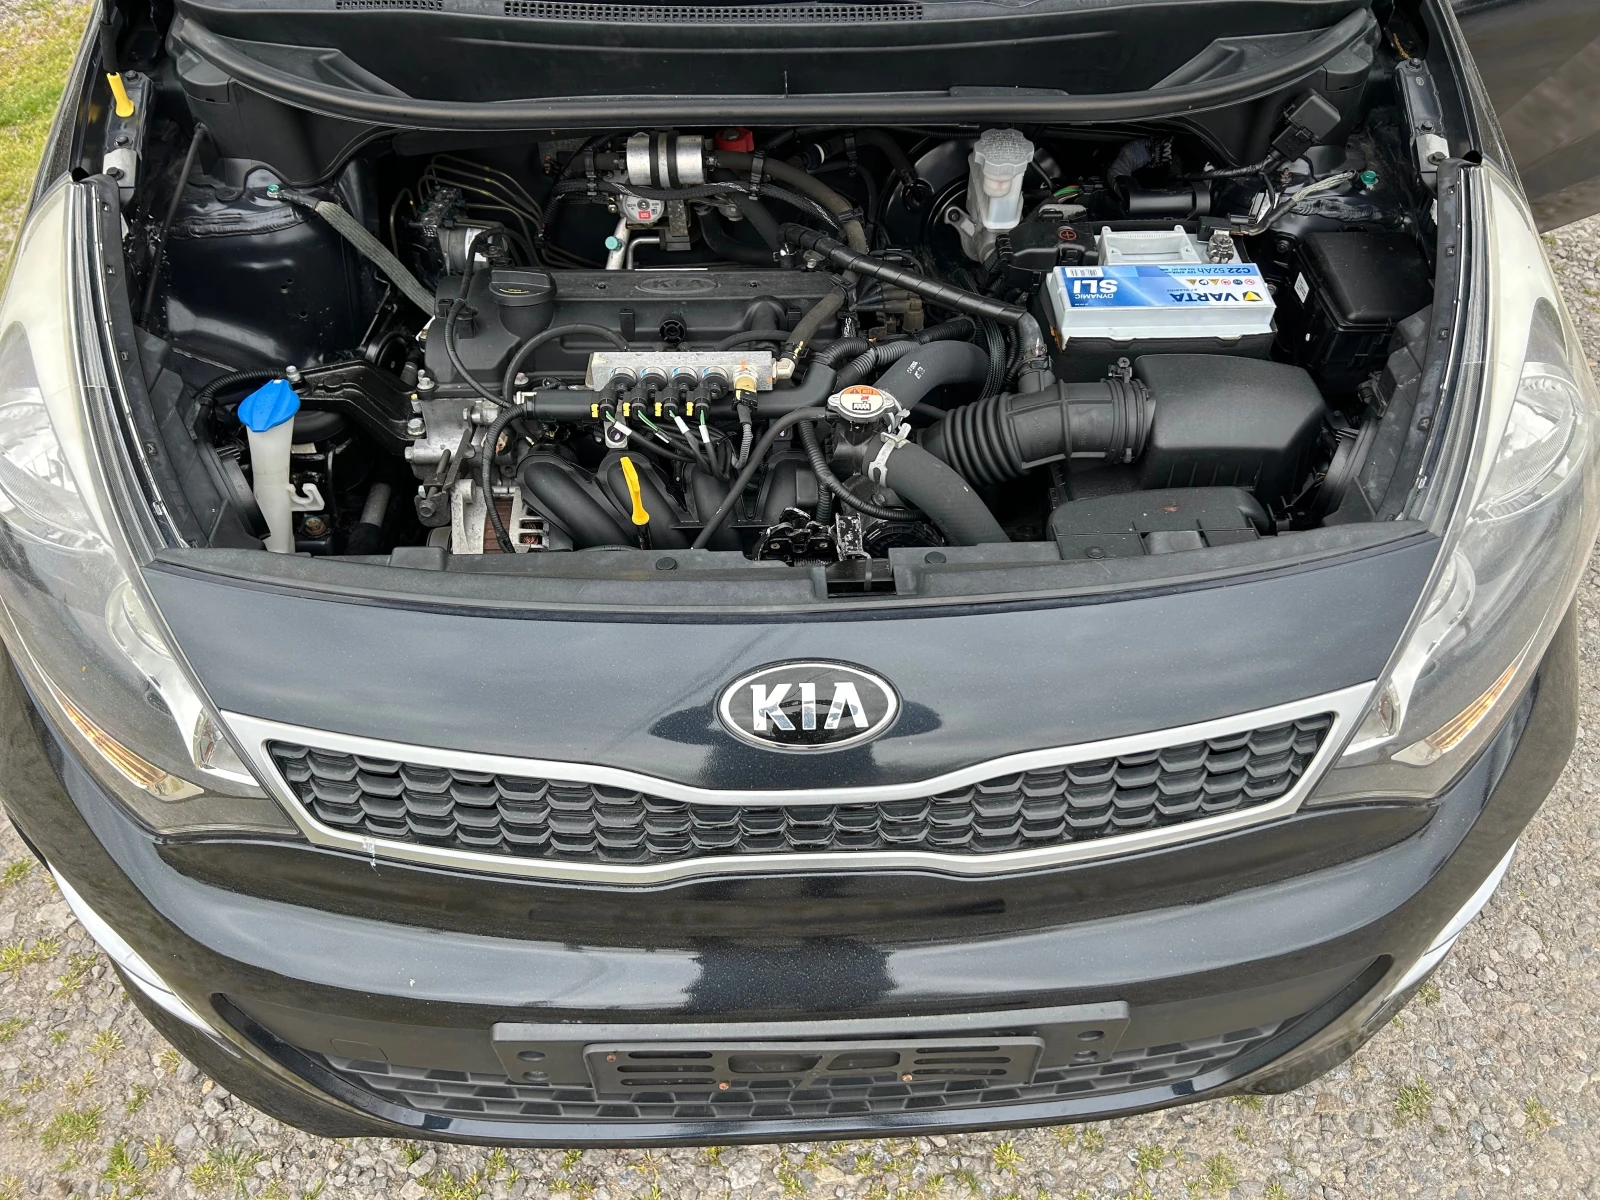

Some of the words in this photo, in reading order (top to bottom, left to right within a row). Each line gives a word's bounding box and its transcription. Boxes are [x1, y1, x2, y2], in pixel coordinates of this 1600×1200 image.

[1073, 279, 1119, 294] SLI
[1169, 292, 1240, 302] VARTA
[750, 681, 870, 731] KIA
